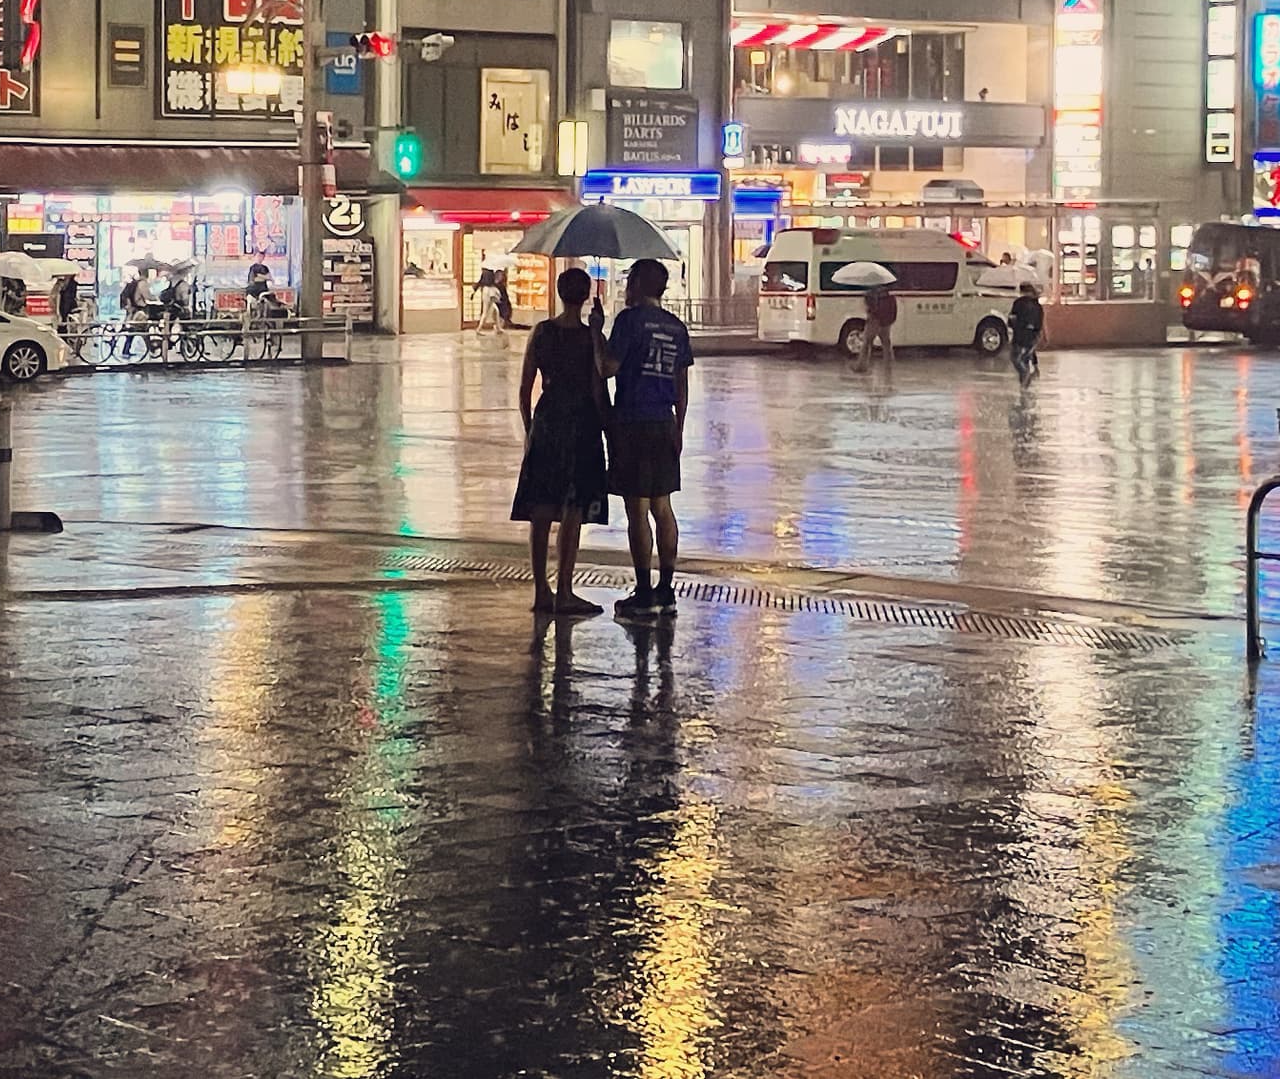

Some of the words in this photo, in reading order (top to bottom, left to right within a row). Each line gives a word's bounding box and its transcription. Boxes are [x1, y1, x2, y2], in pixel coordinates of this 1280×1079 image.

[488, 92, 530, 152] みはし
[622, 114, 687, 127] BILLIARDS
[834, 106, 964, 139] NAGAFUJI
[622, 127, 663, 140] DARTS
[612, 176, 692, 196] LAWSON
